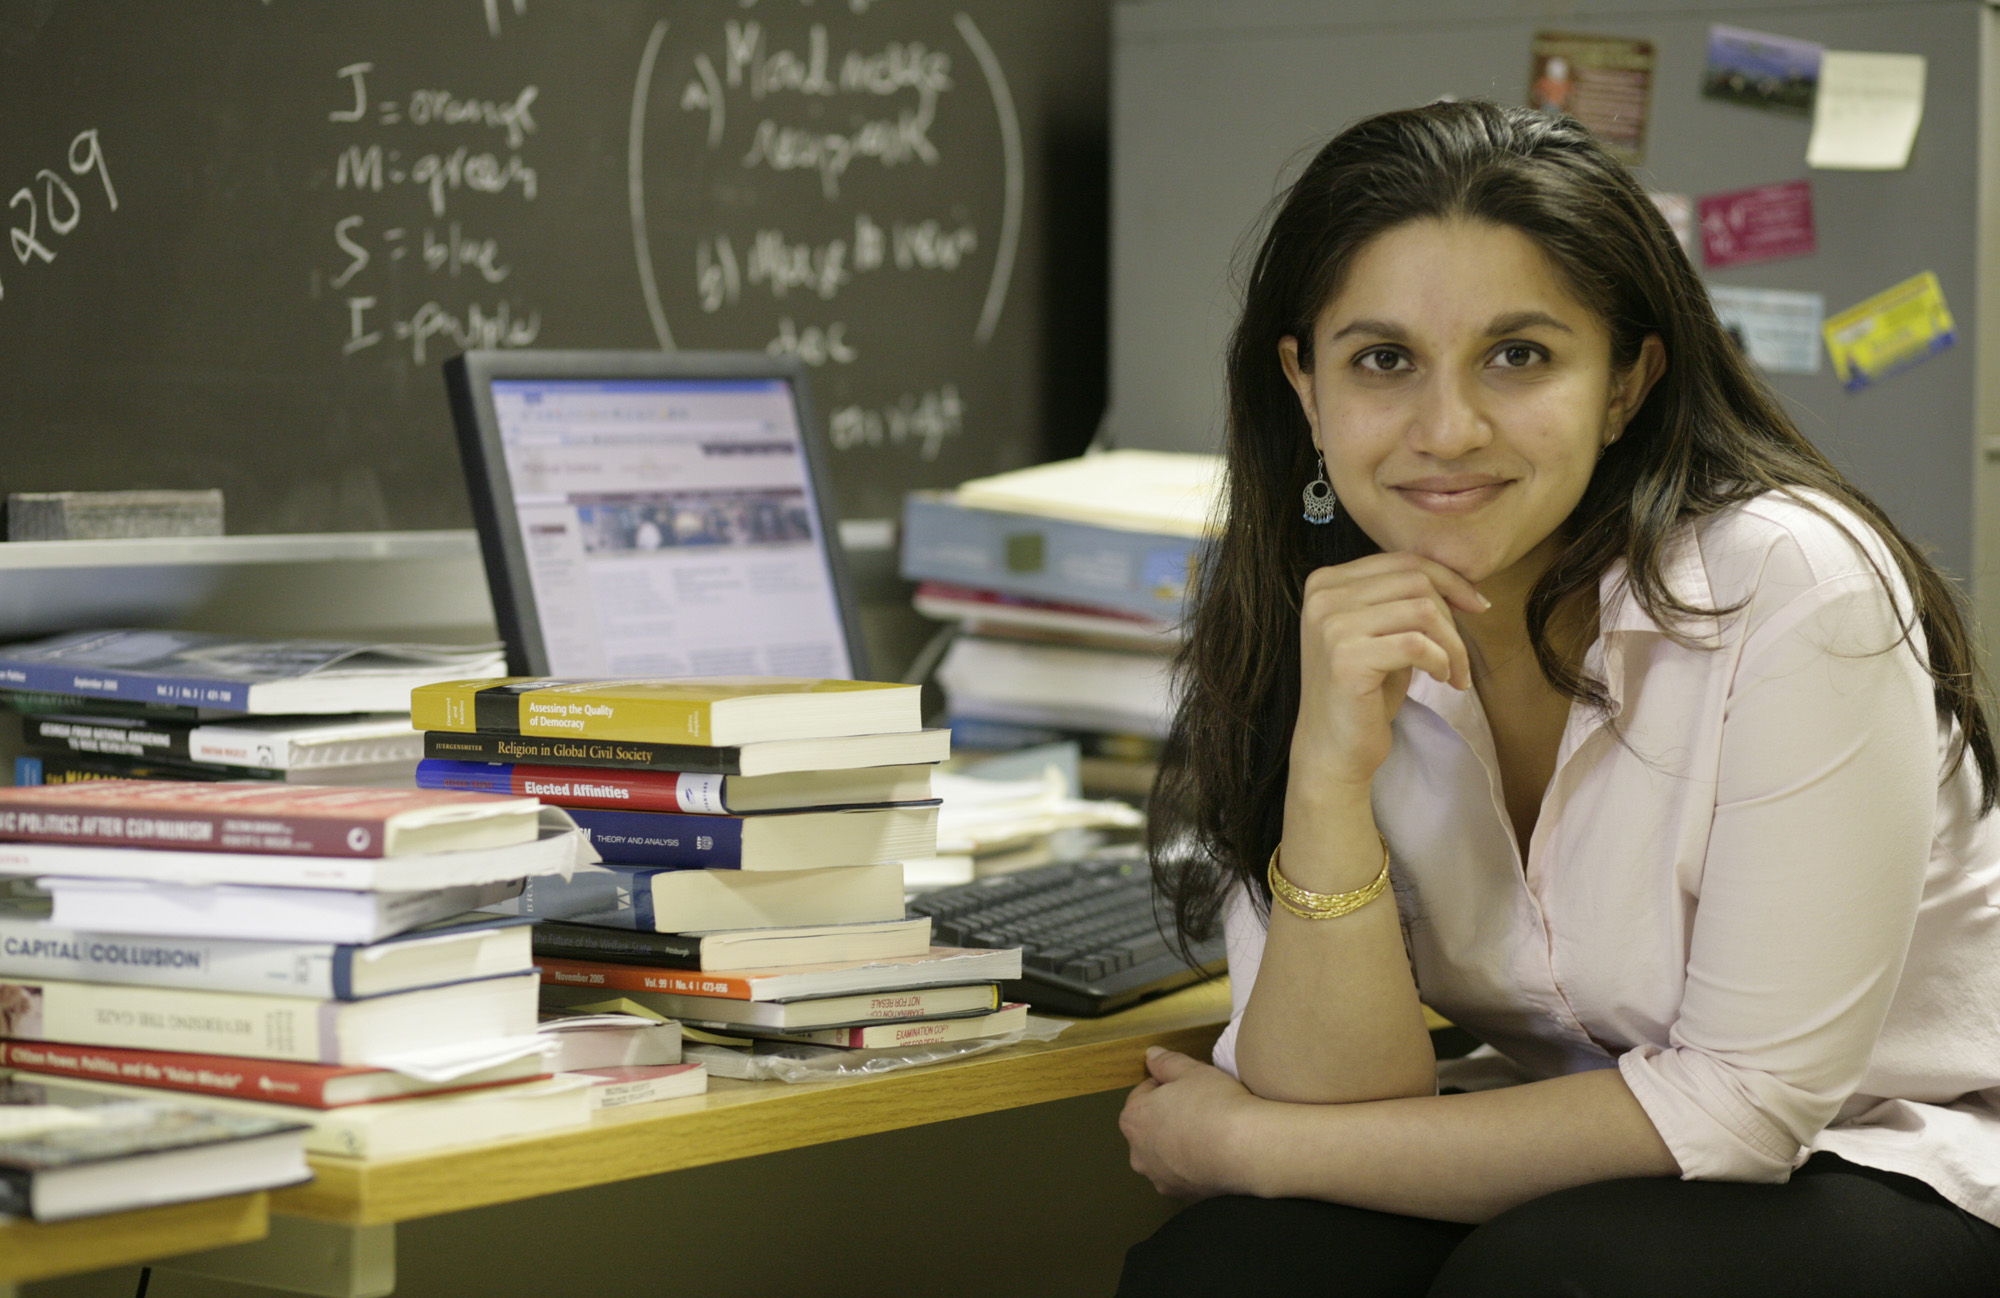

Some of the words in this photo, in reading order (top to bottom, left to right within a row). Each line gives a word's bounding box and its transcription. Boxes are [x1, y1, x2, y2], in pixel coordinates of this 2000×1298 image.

[529, 702, 567, 717] Assessing
[569, 704, 582, 715] the
[584, 704, 614, 719] Quality
[530, 716, 538, 727] of
[540, 718, 584, 732] Democracy
[436, 743, 483, 751] JUERGENSMEYER
[498, 741, 538, 758] Religion
[541, 743, 551, 756] in
[553, 744, 587, 758] Global
[589, 745, 613, 760] Civil
[615, 746, 653, 764] Society
[525, 781, 570, 796] Elected
[573, 783, 630, 799] Affinities
[596, 835, 627, 844] THEORY
[627, 836, 643, 845] AND
[644, 837, 679, 847] ANALYSIS
[534, 933, 547, 944] the
[550, 933, 574, 946] Future
[575, 935, 585, 947] of
[585, 936, 598, 948] the
[5, 938, 81, 960] CAPITAL
[90, 943, 200, 968] COLLUSION
[555, 971, 588, 983] November
[589, 973, 605, 984] 2005
[644, 977, 657, 988] Vol.
[658, 978, 667, 988] 99
[675, 980, 687, 989] No.
[702, 982, 728, 993] 473-656
[871, 999, 894, 1009] RESALE
[895, 997, 907, 1007] FOR
[908, 996, 921, 1006] NOT
[896, 1025, 934, 1040] EXAMINATION
[934, 1024, 950, 1036] COPY
